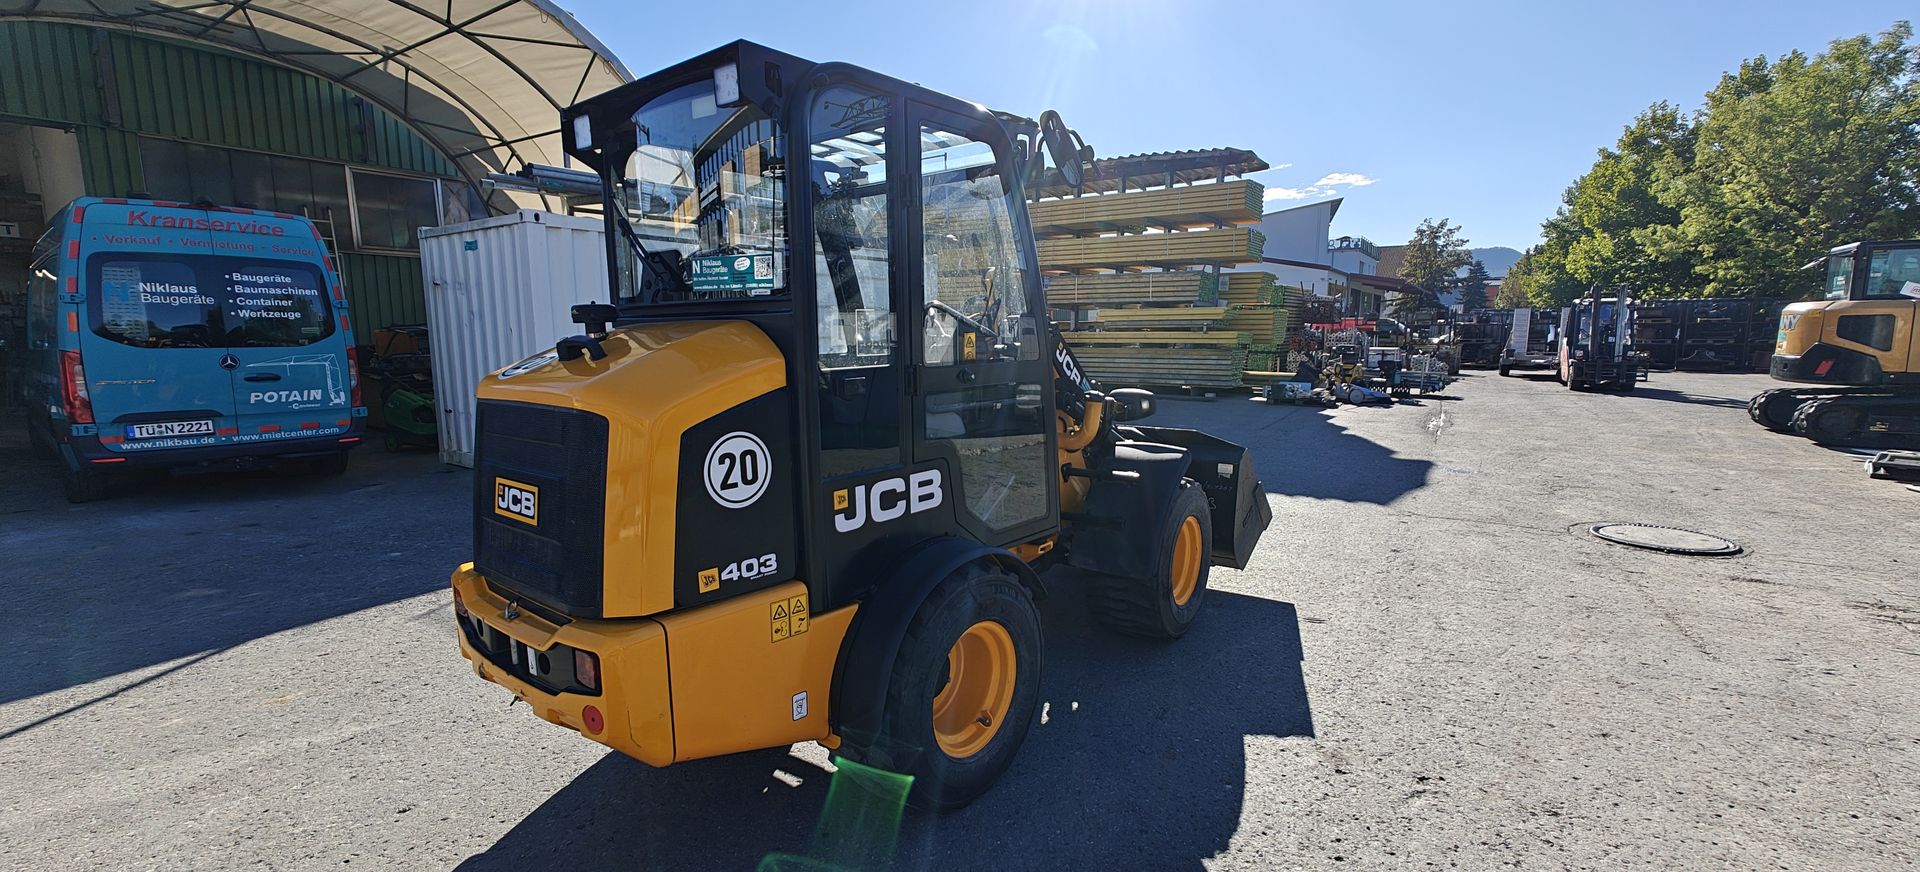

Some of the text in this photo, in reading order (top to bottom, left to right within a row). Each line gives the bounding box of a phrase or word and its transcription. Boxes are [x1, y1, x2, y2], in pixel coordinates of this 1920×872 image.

[127, 210, 285, 237] Kranservice
[103, 234, 314, 257] Verkauf Vermietung Service
[232, 272, 292, 284] Baugeräte
[138, 282, 198, 294] Niklaus
[234, 285, 318, 296] Baumaschinen
[141, 293, 215, 306] Baugeräte
[236, 297, 293, 307] Container
[237, 309, 302, 320] Werkzeuge
[250, 389, 322, 404] POTAIN
[120, 426, 340, 450] www.nikbau.de www.mietcenter.com
[136, 421, 212, 438] TÜ N 2221
[718, 449, 759, 491] 20
[498, 486, 535, 517] JCB
[834, 469, 943, 533] JCB
[721, 553, 778, 581] 403
